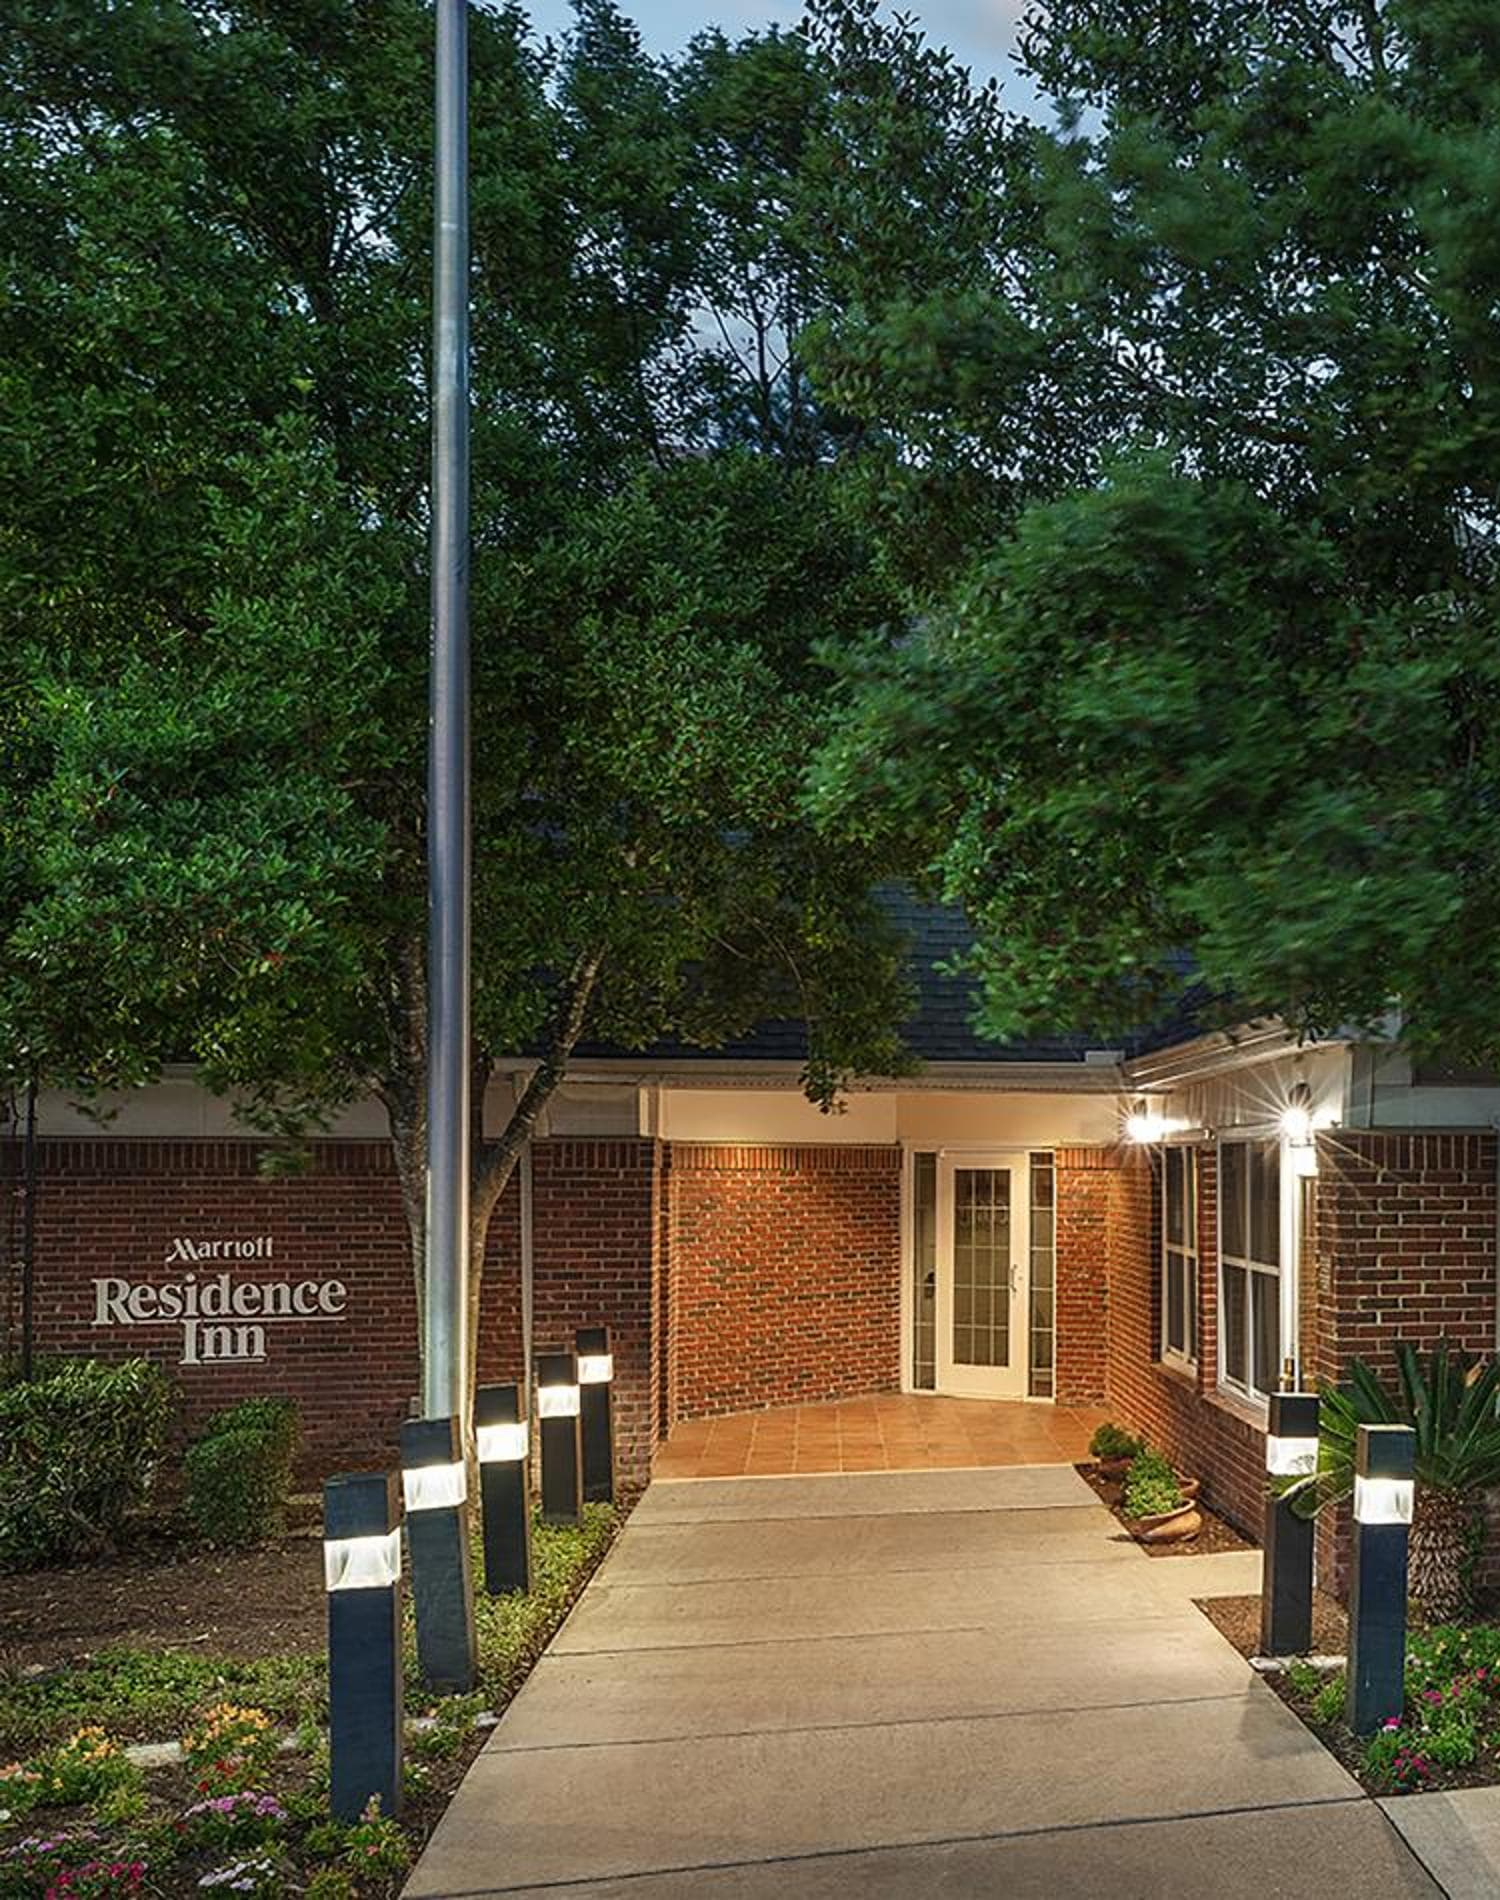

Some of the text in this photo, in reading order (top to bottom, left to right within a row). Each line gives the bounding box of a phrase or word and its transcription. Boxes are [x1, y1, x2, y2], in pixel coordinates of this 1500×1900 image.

[166, 1237, 273, 1262] Marriott
[91, 1273, 347, 1325] Residence
[179, 1319, 268, 1364] Inn
